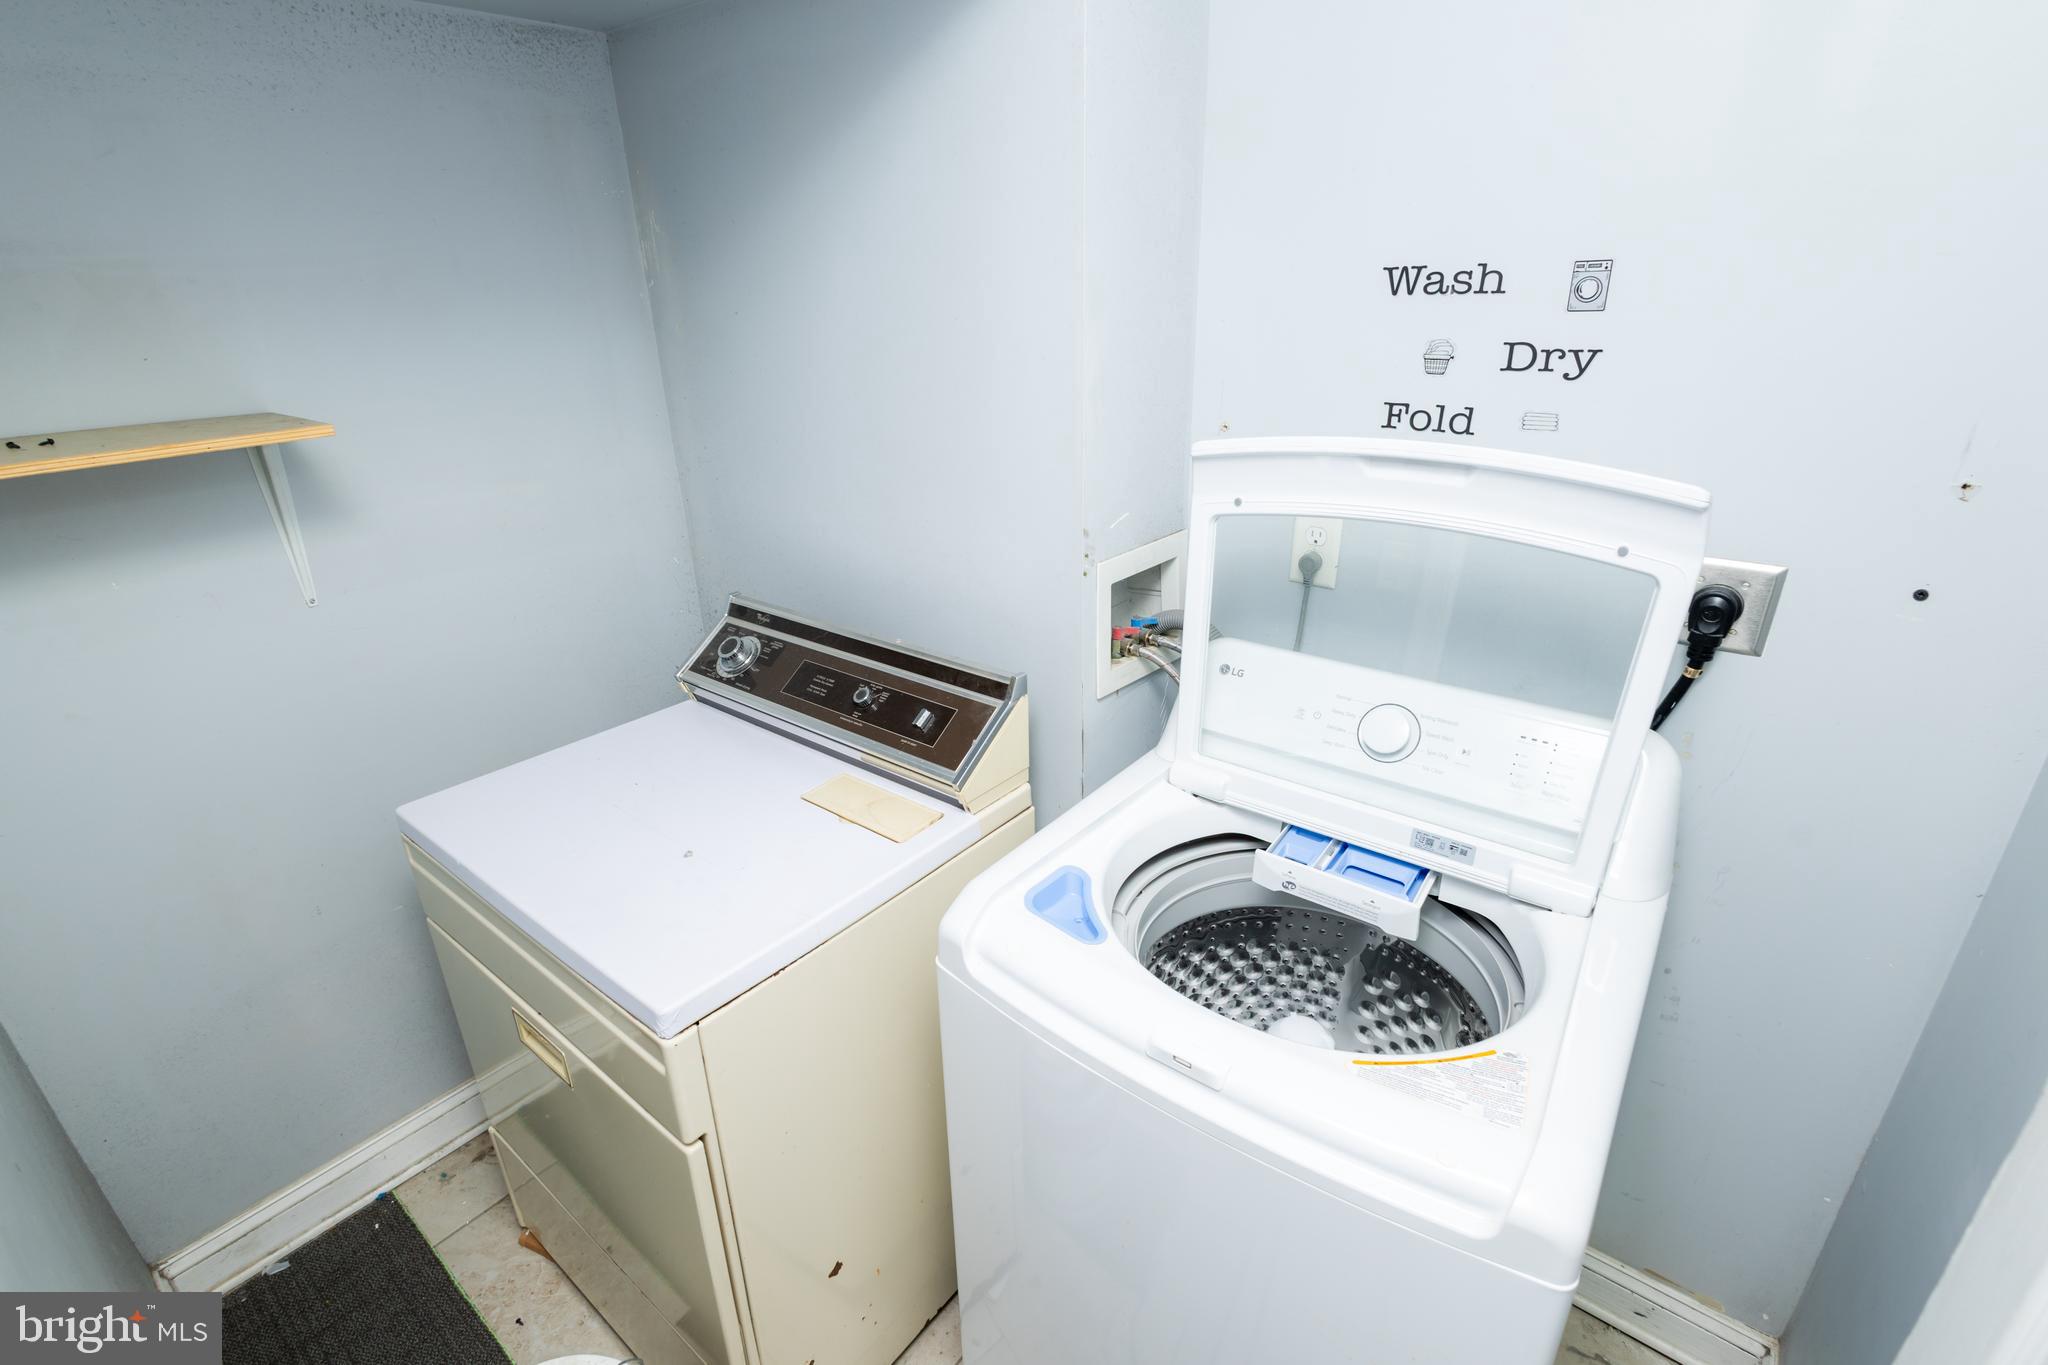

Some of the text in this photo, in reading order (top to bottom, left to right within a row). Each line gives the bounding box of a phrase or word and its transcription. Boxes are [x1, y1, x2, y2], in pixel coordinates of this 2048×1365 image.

[1383, 263, 1506, 296] Wash
[1500, 342, 1603, 381] Dry
[1381, 402, 1475, 435] Fold
[1231, 667, 1245, 678] LG
